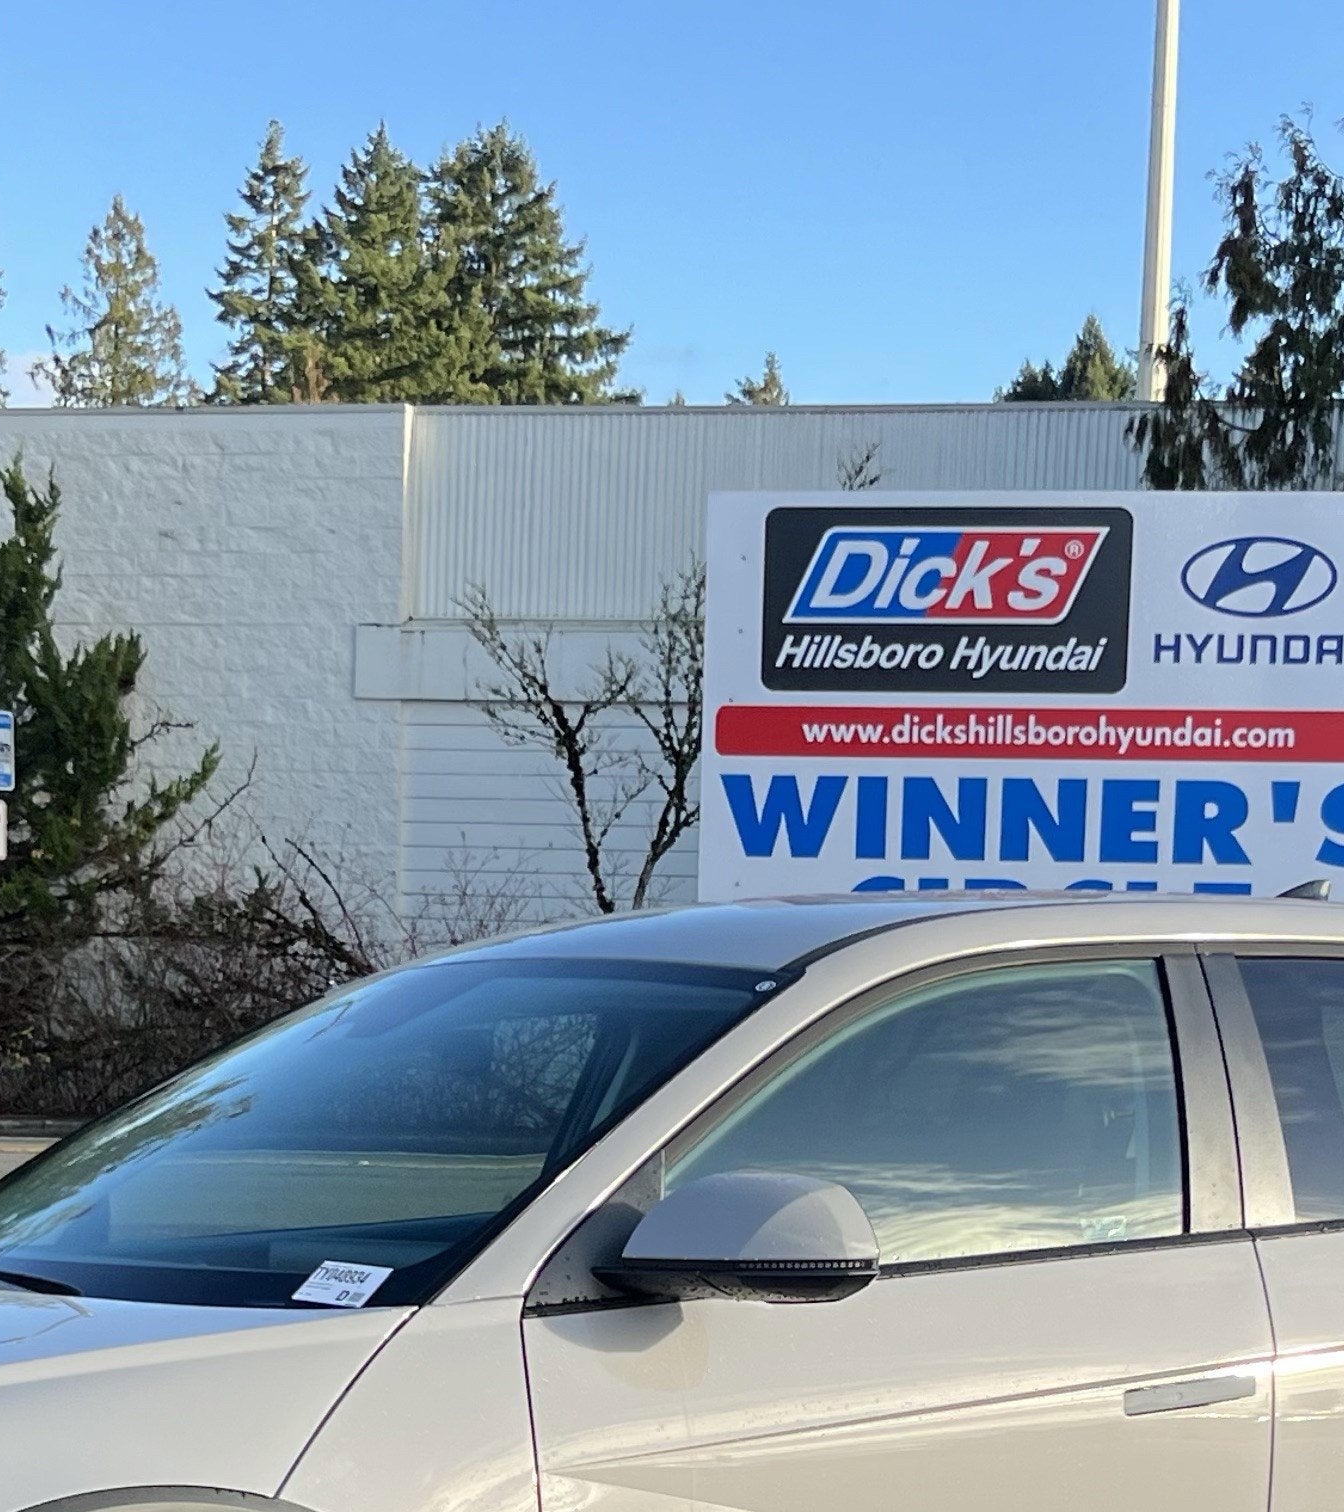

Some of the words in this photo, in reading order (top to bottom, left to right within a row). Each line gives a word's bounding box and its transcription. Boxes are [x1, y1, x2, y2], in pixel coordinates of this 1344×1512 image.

[808, 537, 1068, 612] Dick's
[775, 634, 945, 670] Hillsboro
[949, 636, 1108, 679] Hyundai
[802, 713, 1295, 755] www.dickshillsborohyundai.com
